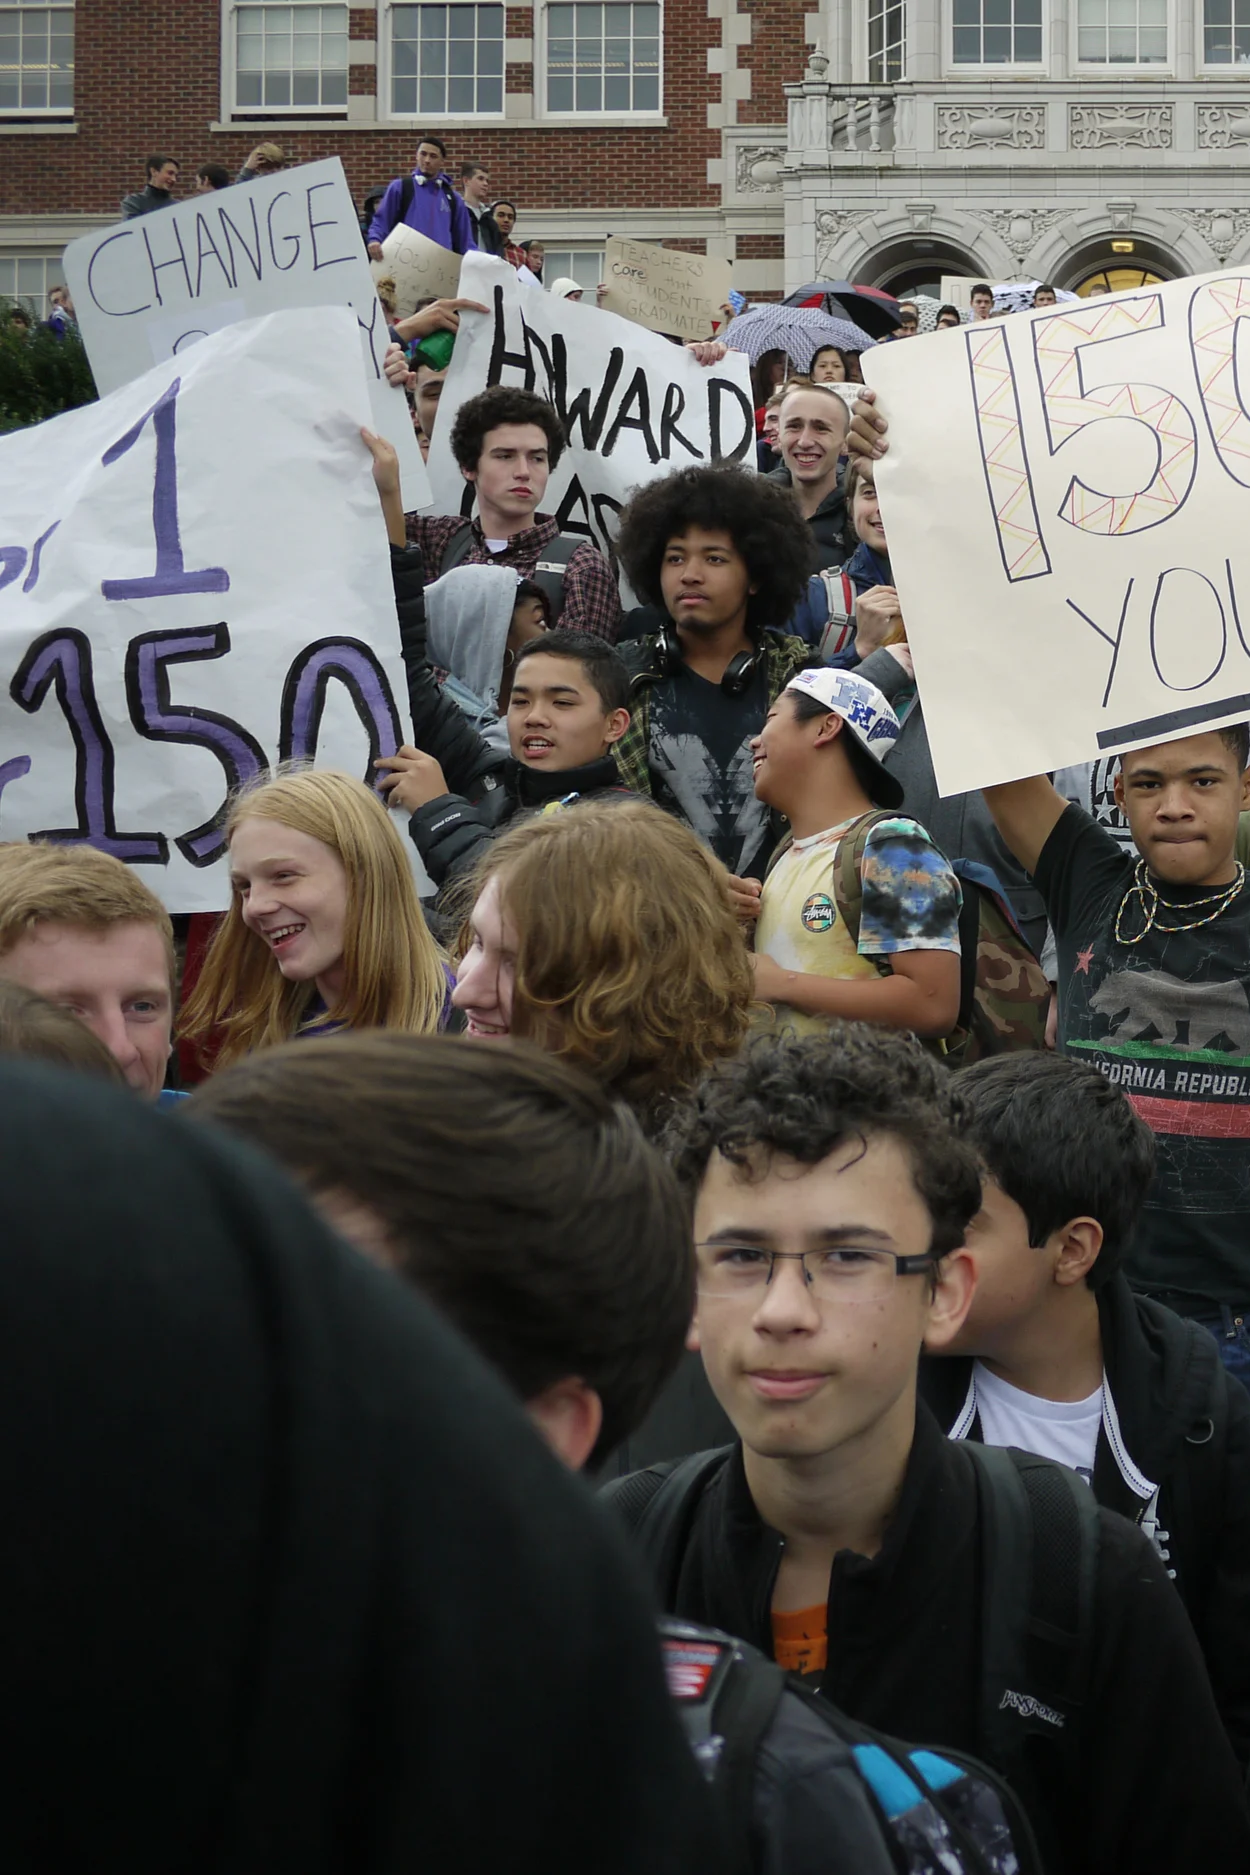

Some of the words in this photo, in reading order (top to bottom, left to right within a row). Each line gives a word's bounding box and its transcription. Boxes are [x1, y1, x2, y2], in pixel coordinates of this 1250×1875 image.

[87, 182, 358, 316] CHANGE
[614, 240, 704, 278] TEACHERS
[620, 278, 712, 315] STUDENTS
[626, 298, 709, 335] GRADUATE
[101, 376, 230, 601] 1
[9, 621, 405, 868] 150
